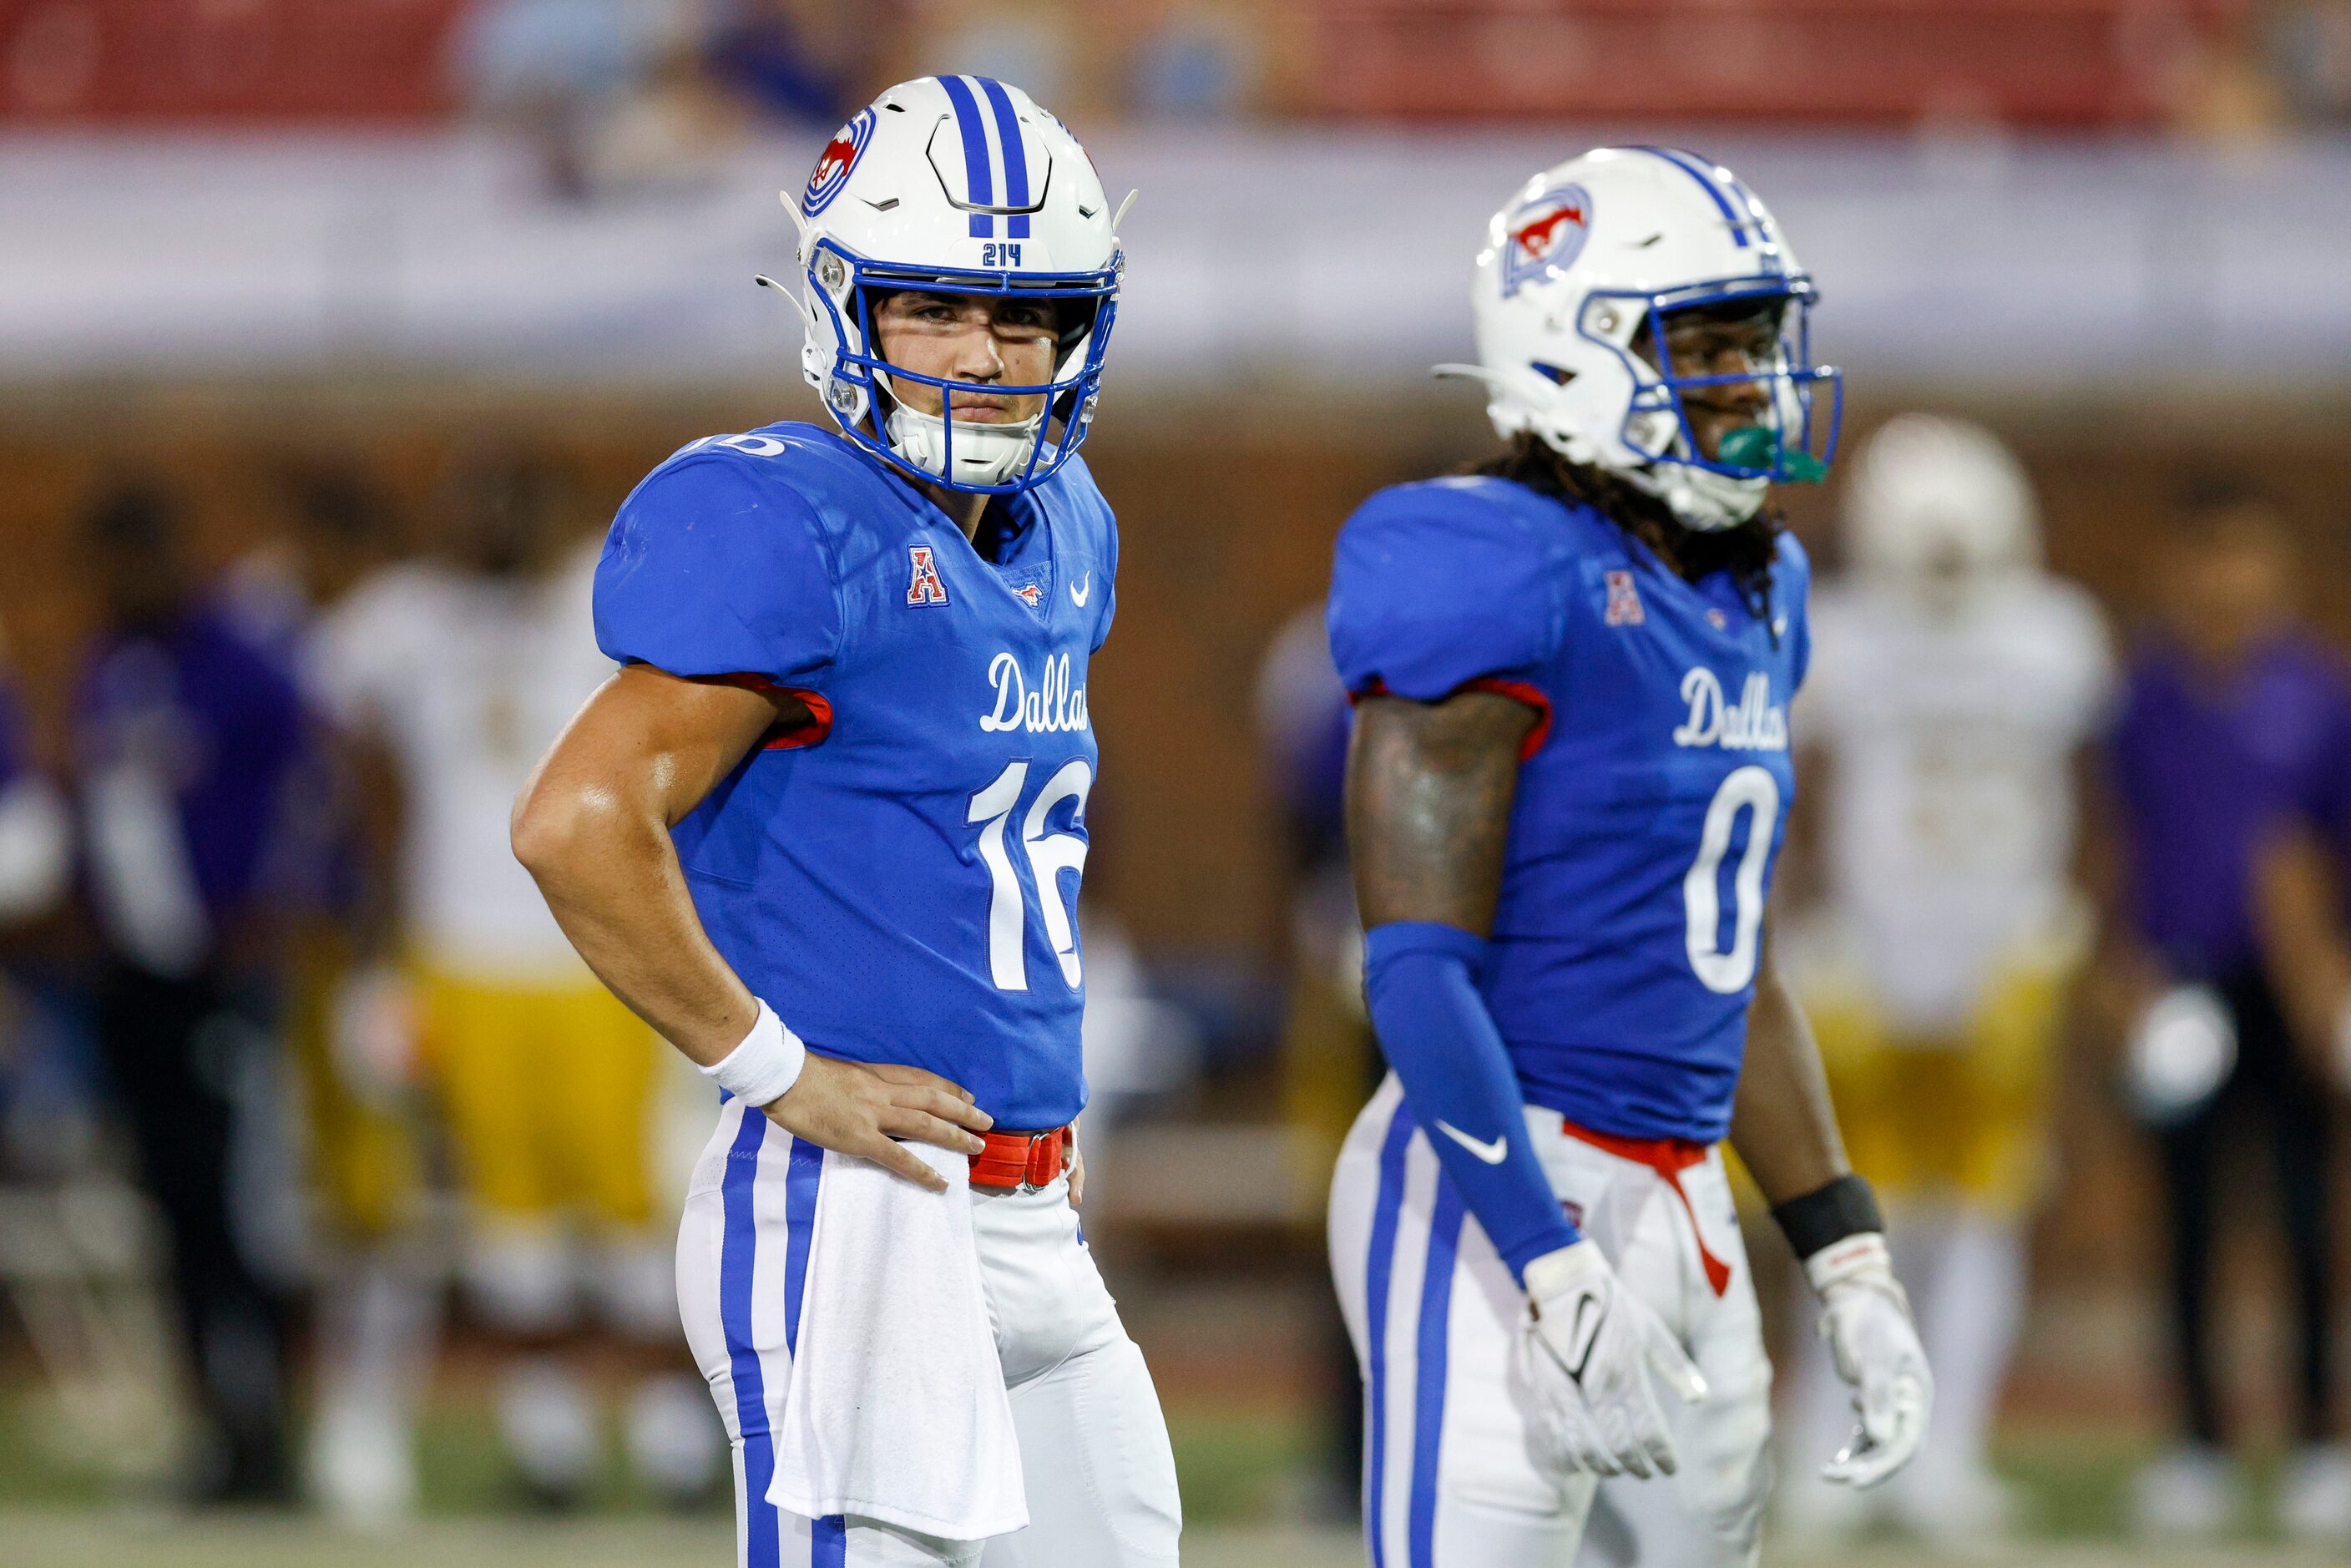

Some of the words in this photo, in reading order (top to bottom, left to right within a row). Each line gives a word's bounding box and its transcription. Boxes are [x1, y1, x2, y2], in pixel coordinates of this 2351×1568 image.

[983, 243, 1021, 267] 214
[1672, 666, 1787, 750] Dalla
[963, 756, 1089, 994] 16
[1683, 766, 1779, 994] 0
